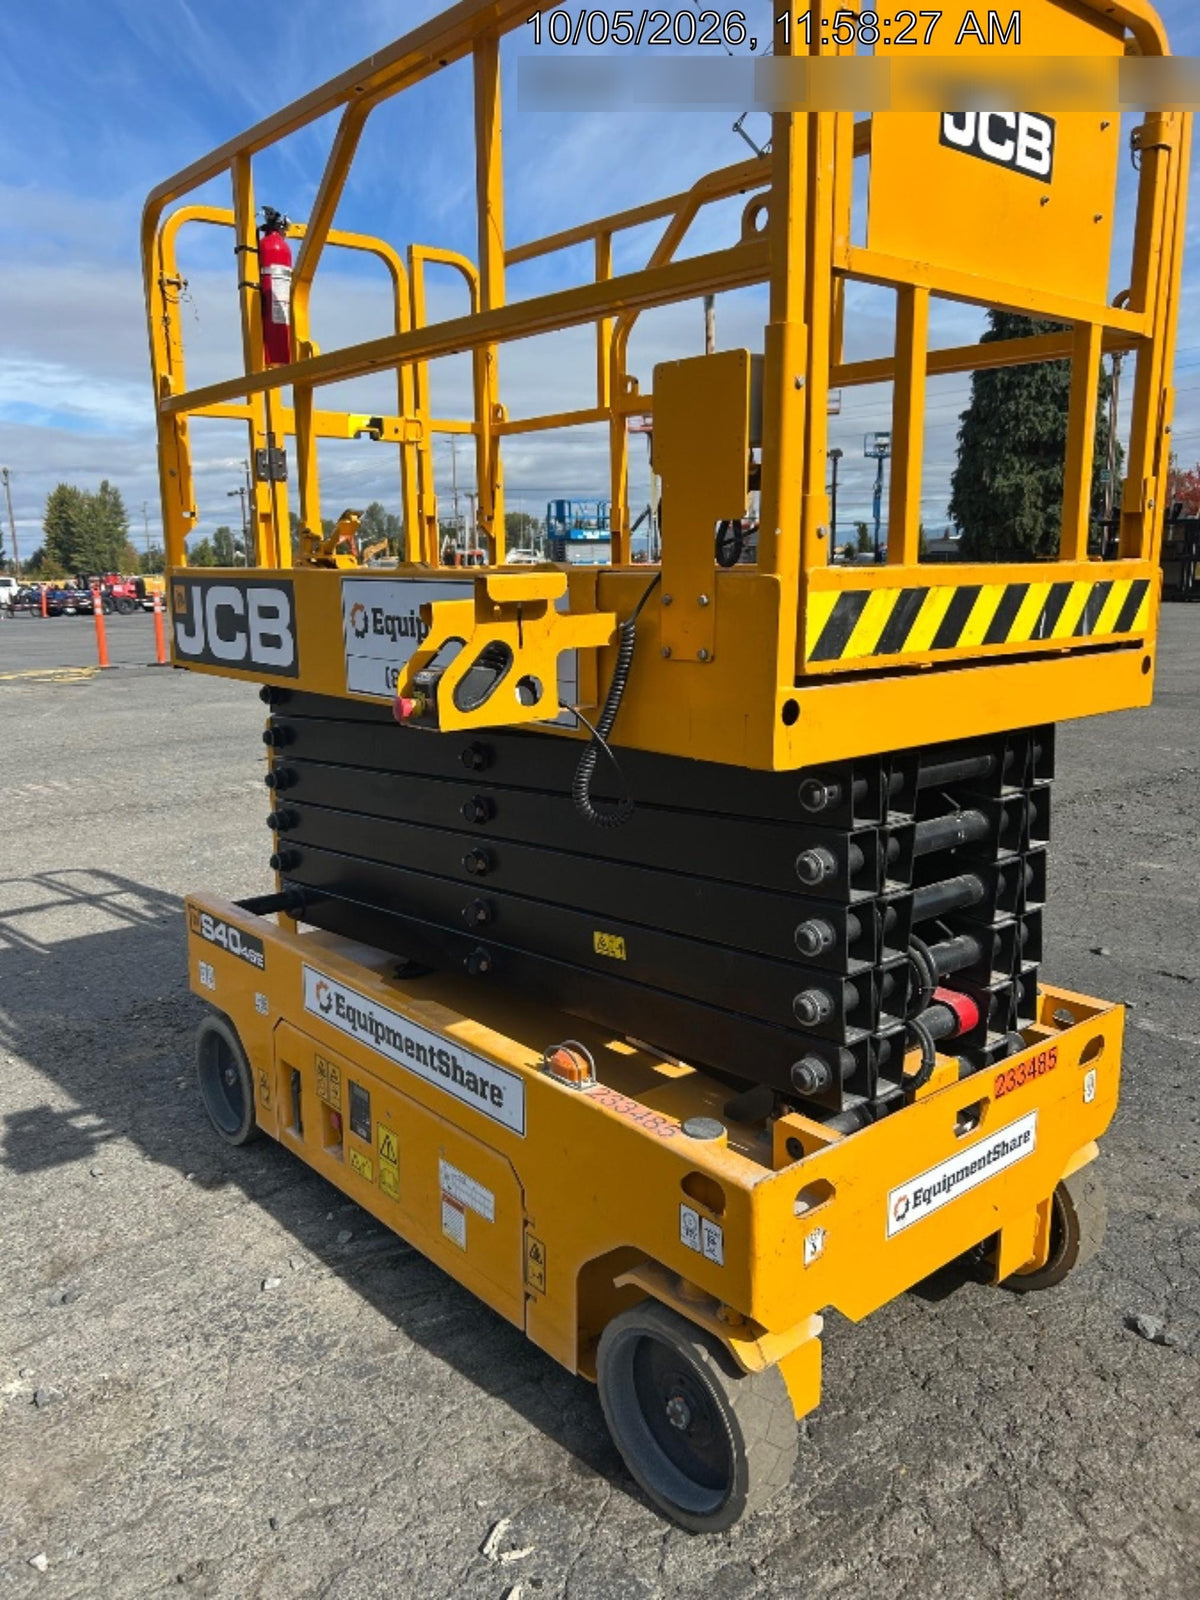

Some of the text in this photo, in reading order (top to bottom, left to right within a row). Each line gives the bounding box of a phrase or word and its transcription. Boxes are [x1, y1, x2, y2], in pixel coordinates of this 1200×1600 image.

[943, 112, 1052, 175] JCB
[175, 585, 294, 667] JCB
[371, 607, 429, 645] Equip
[335, 993, 504, 1109] EquipmentShare
[996, 1046, 1057, 1099] 233485
[586, 1087, 676, 1137] 233485
[912, 1129, 1031, 1209] EquipmentShare
